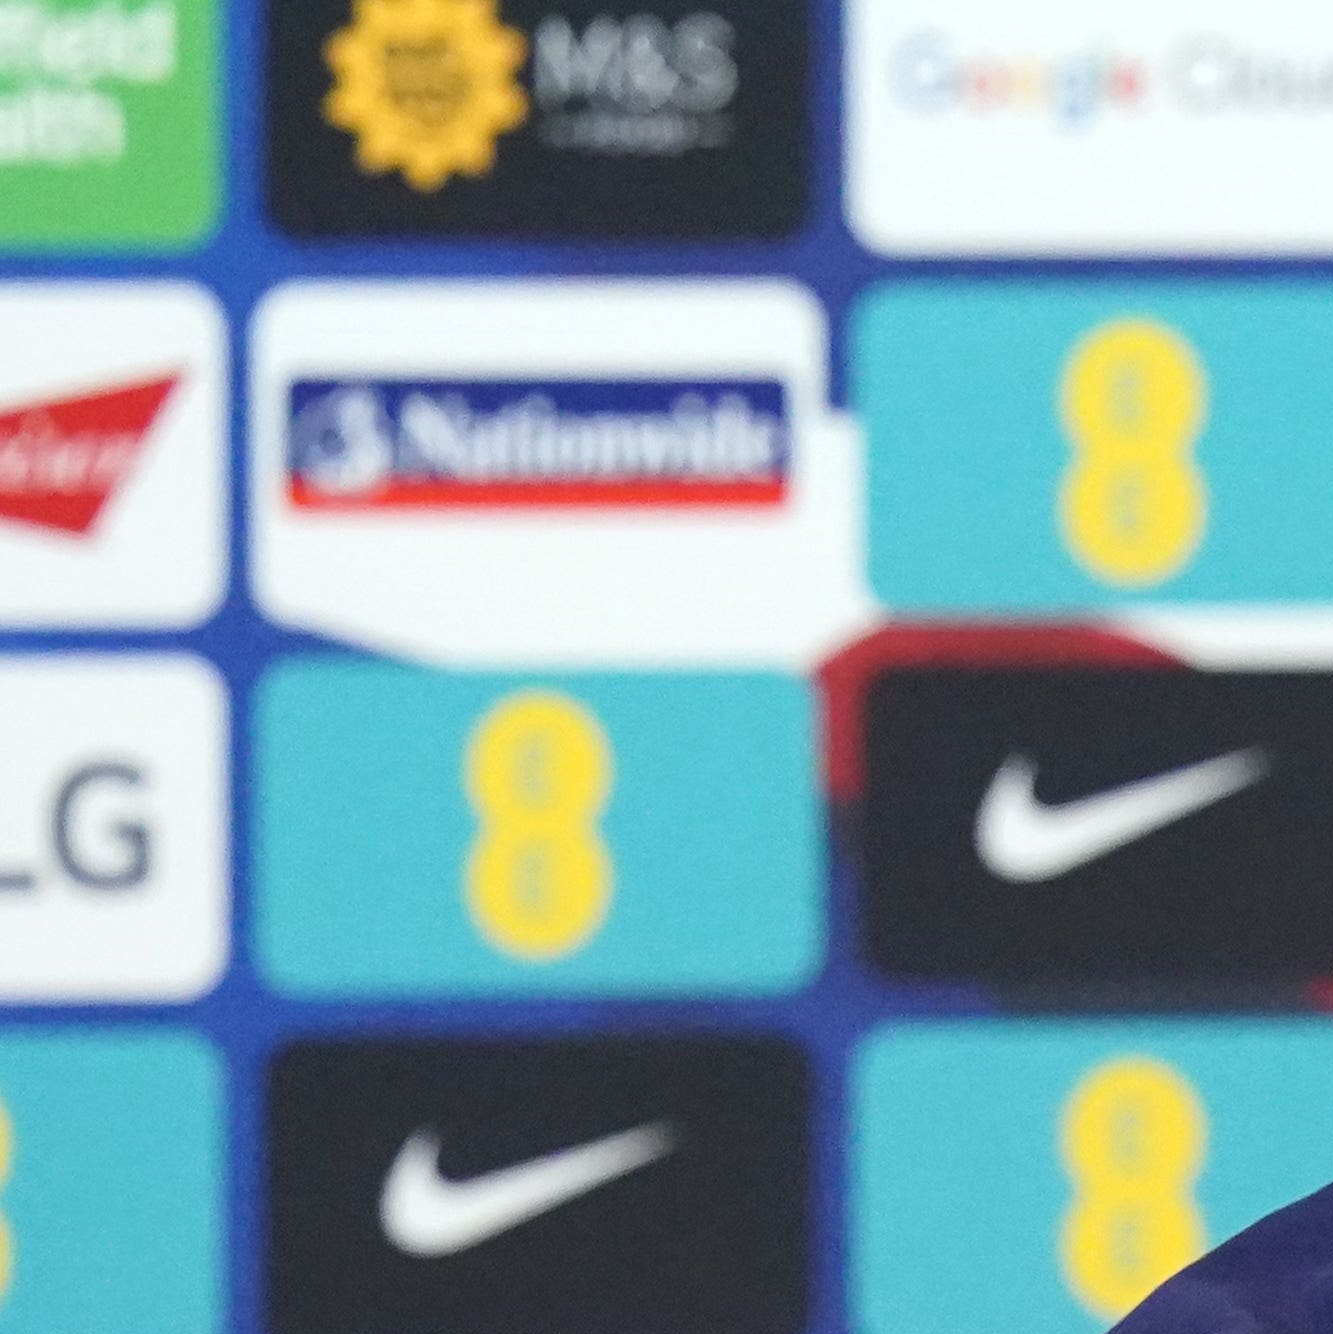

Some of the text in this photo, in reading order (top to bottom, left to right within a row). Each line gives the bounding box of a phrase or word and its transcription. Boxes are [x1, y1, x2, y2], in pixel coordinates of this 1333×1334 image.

[533, 14, 738, 110] M&S
[885, 32, 1150, 130] Google
[403, 394, 784, 484] Nationwide
